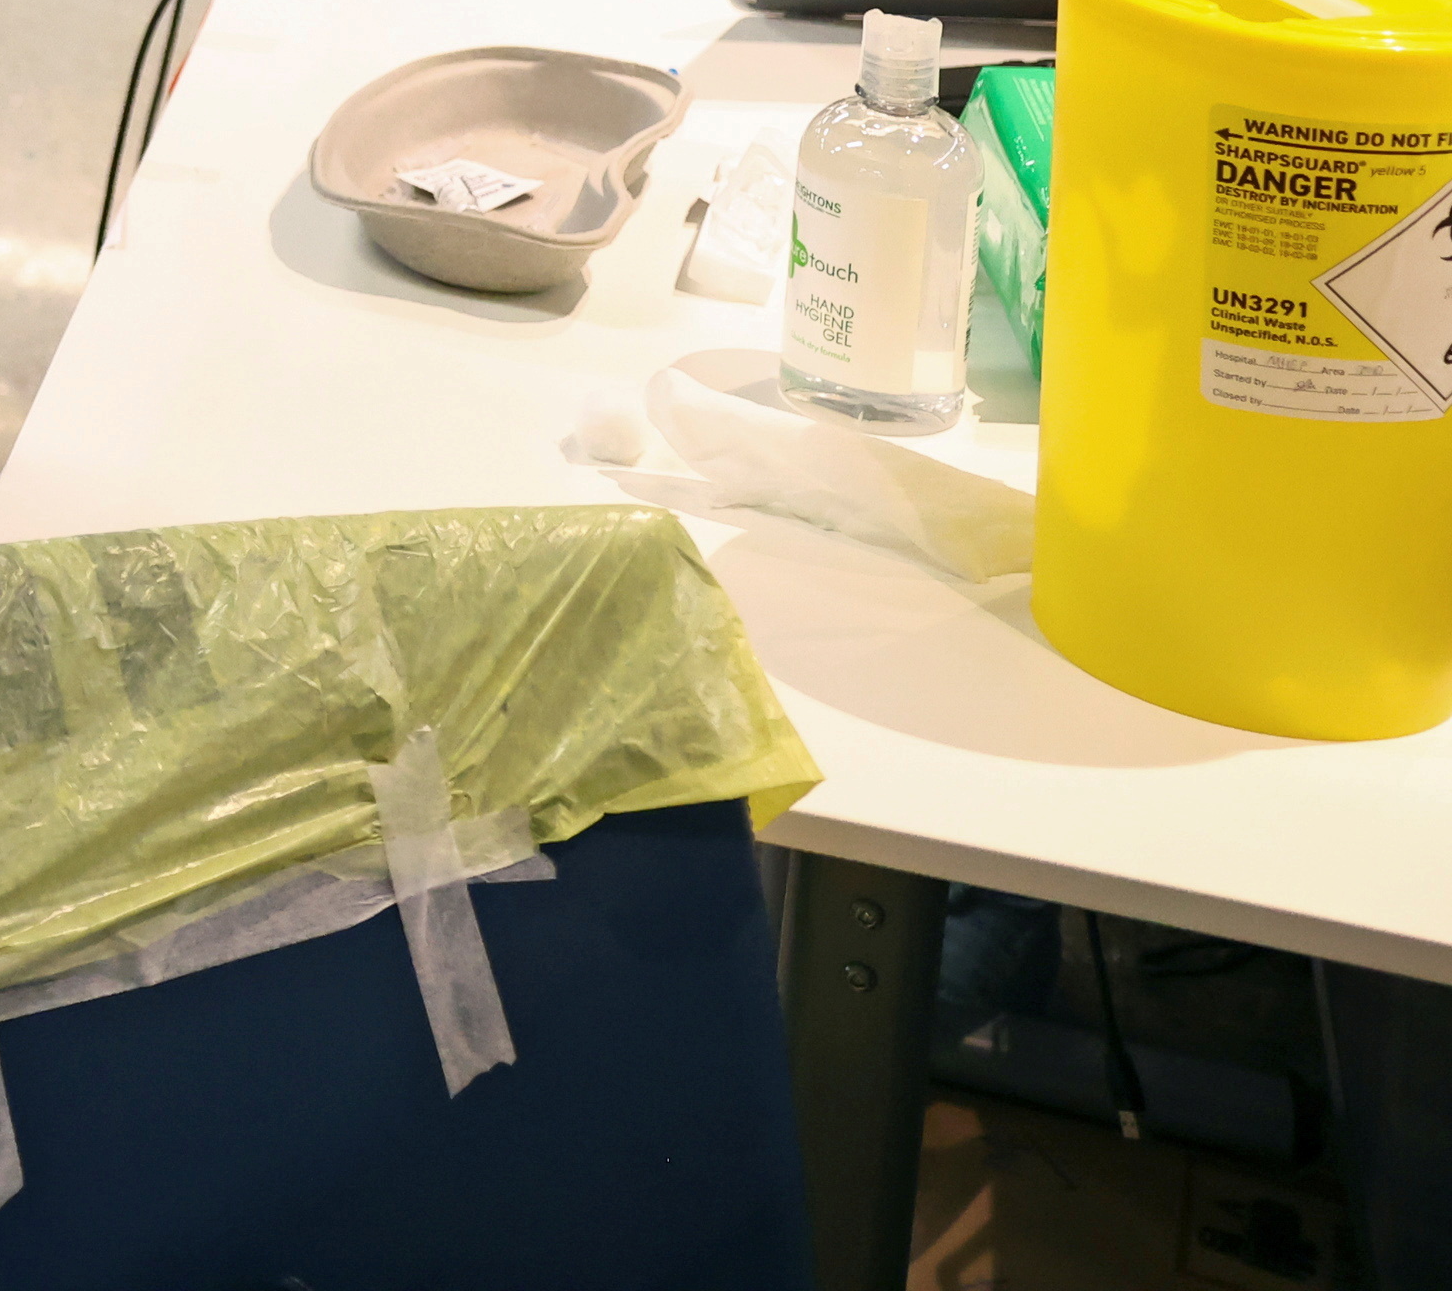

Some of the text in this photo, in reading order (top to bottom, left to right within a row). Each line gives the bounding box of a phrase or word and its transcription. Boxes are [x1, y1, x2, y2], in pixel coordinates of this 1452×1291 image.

[1244, 118, 1452, 148] WARNING DO NOT FI
[1216, 159, 1357, 201] DANGER
[1370, 163, 1415, 178] yellow
[1418, 165, 1427, 176] 5
[1215, 196, 1229, 205] OR
[1231, 200, 1263, 212] OTHER
[1216, 183, 1399, 215] DESTROY BY INCINERATION
[1279, 218, 1326, 230] PROCESS
[810, 252, 859, 284] touch
[810, 293, 855, 319] HAND
[1212, 286, 1308, 318] UN3291
[795, 299, 854, 334] HYGIENE
[1211, 307, 1307, 333] Clinical Waste
[822, 328, 853, 348] GEL
[1211, 320, 1339, 348] Unspecified, N.O.S.
[1215, 349, 1257, 366] Hospital
[1321, 366, 1345, 376] Area
[1213, 369, 1348, 396] Started by Date
[1212, 387, 1360, 415] Closed by Date
